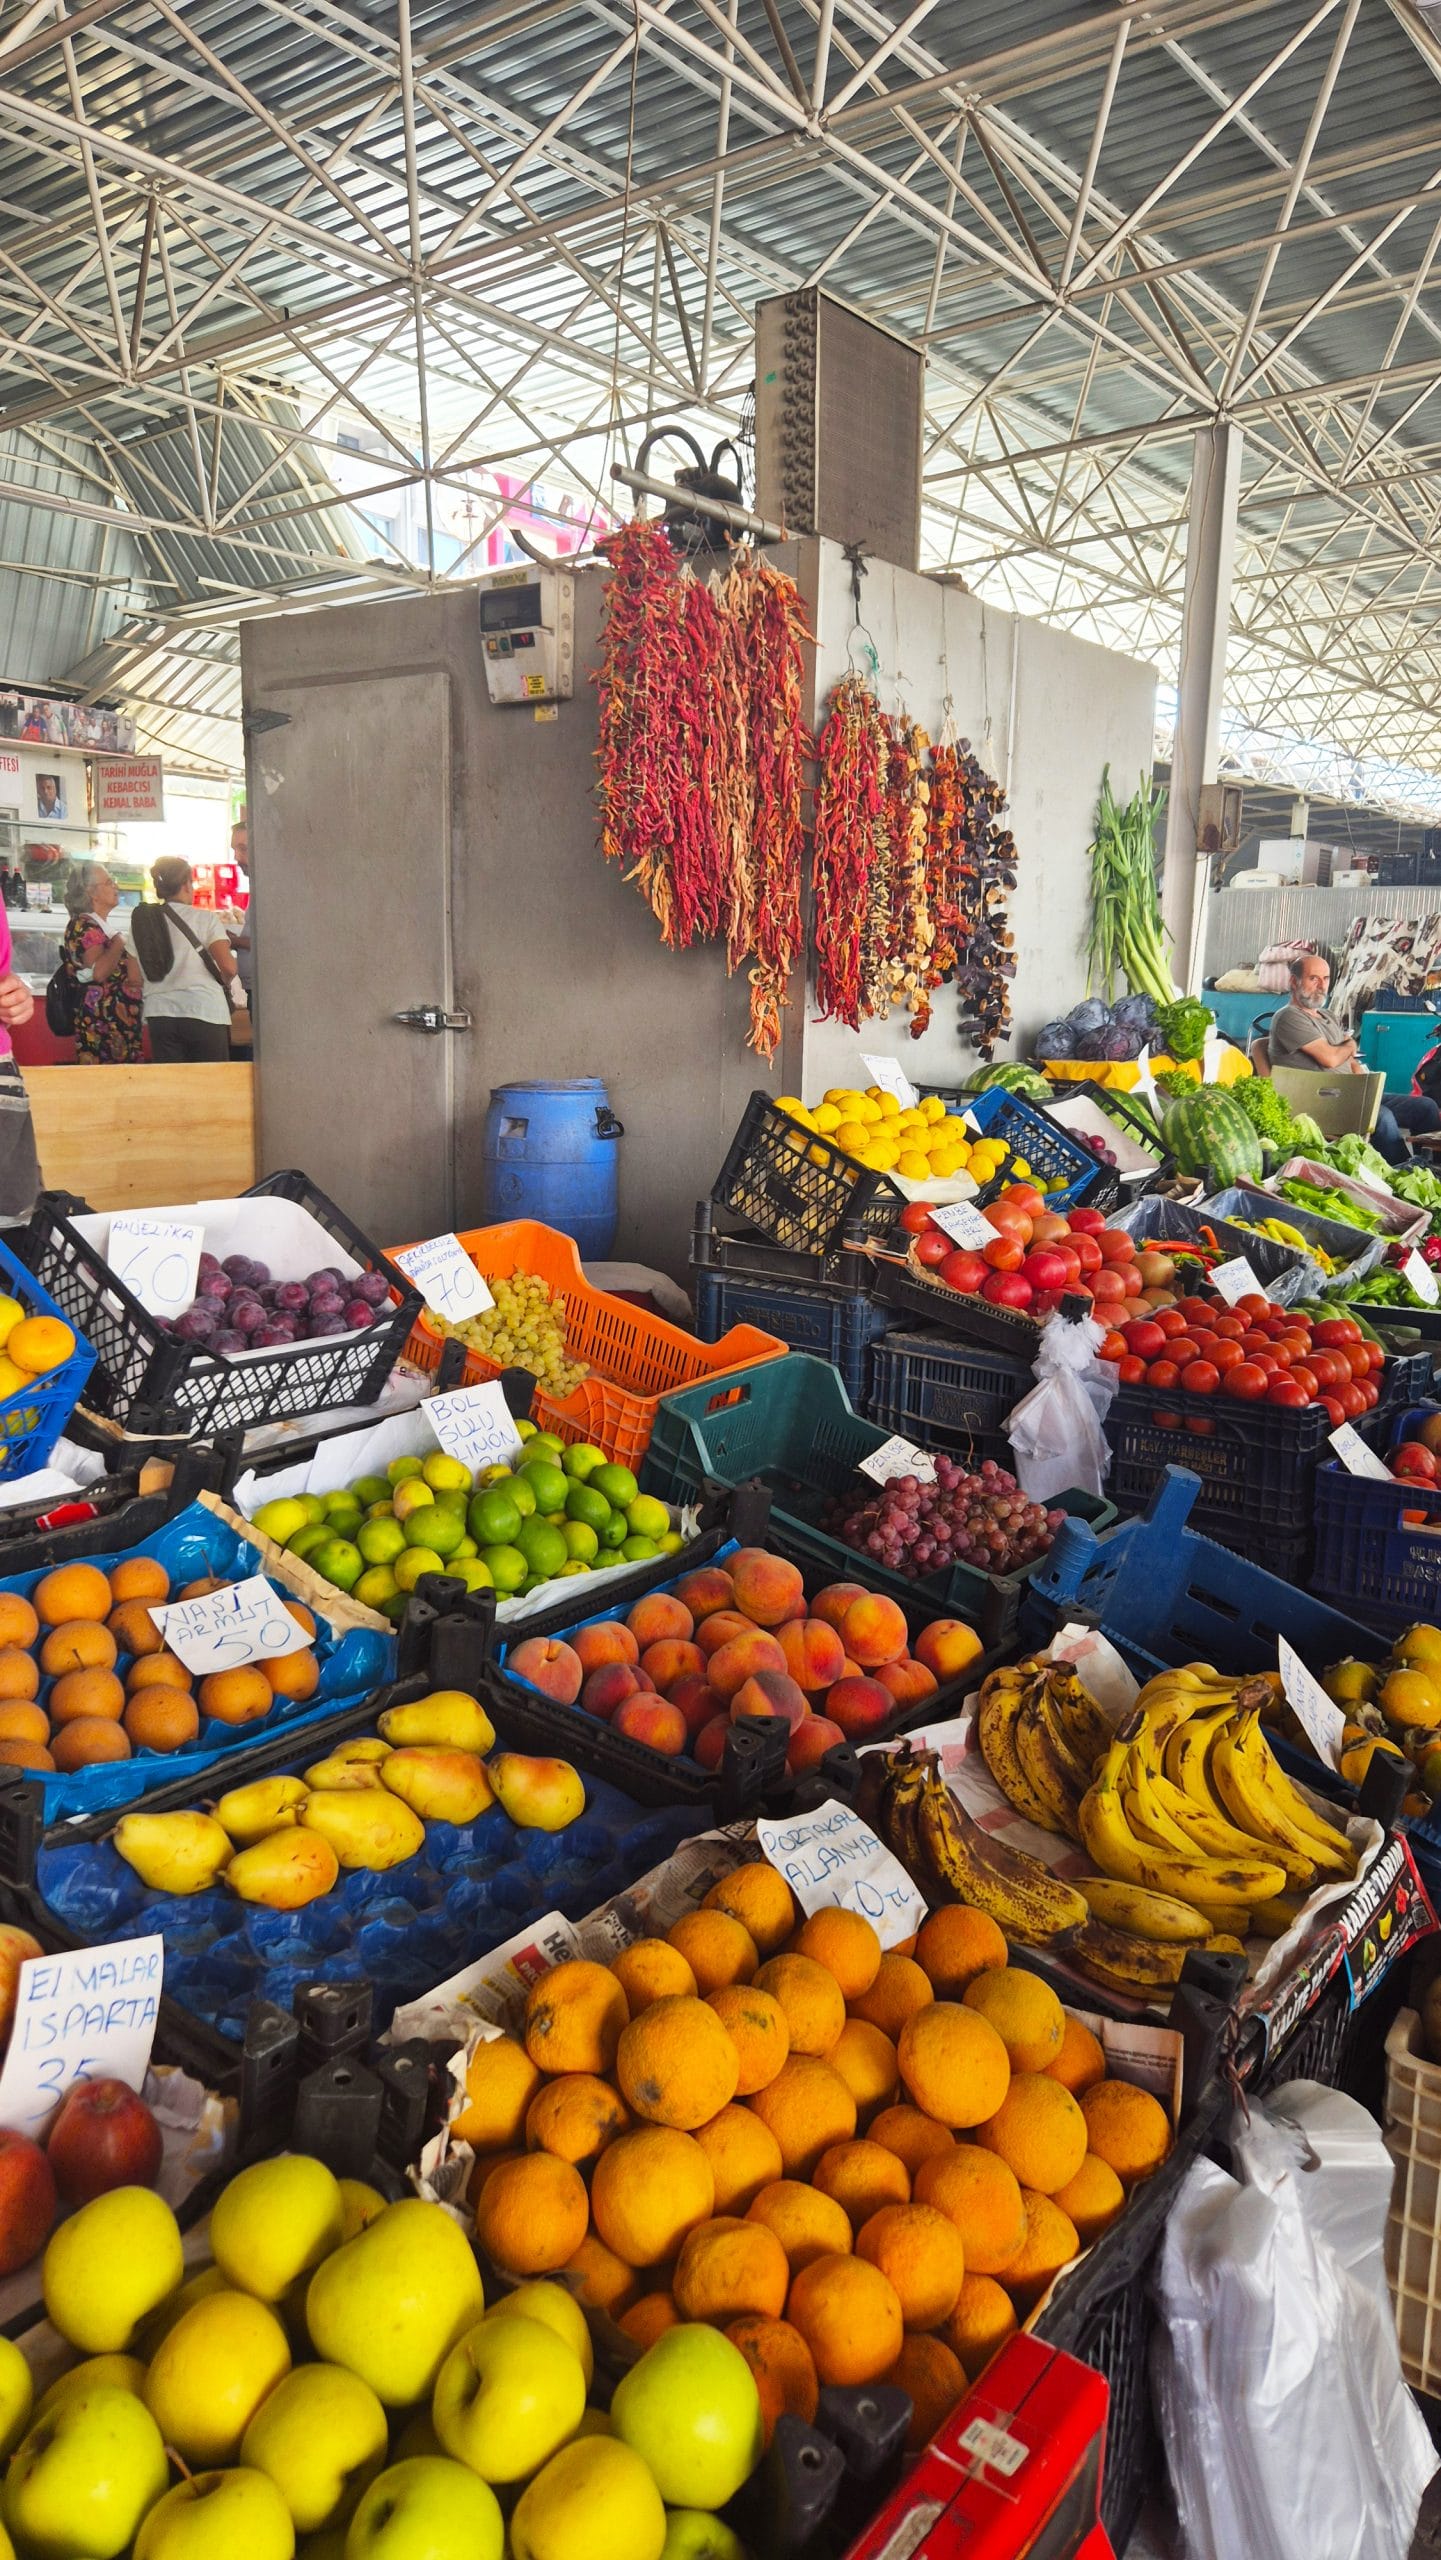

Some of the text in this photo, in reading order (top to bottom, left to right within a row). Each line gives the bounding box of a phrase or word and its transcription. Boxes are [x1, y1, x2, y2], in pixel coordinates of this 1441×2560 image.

[128, 762, 158, 777] MUĞLA
[103, 796, 157, 809] KEMAL BABA
[119, 1246, 190, 1303] 60
[426, 1266, 475, 1312] 70
[430, 1395, 481, 1421] BOL
[438, 1410, 495, 1444] SULU
[176, 1598, 272, 1644] ARMUT
[212, 1619, 291, 1671] 50
[785, 1834, 881, 1891] ALANYA
[23, 1996, 157, 2051] ISPARTA
